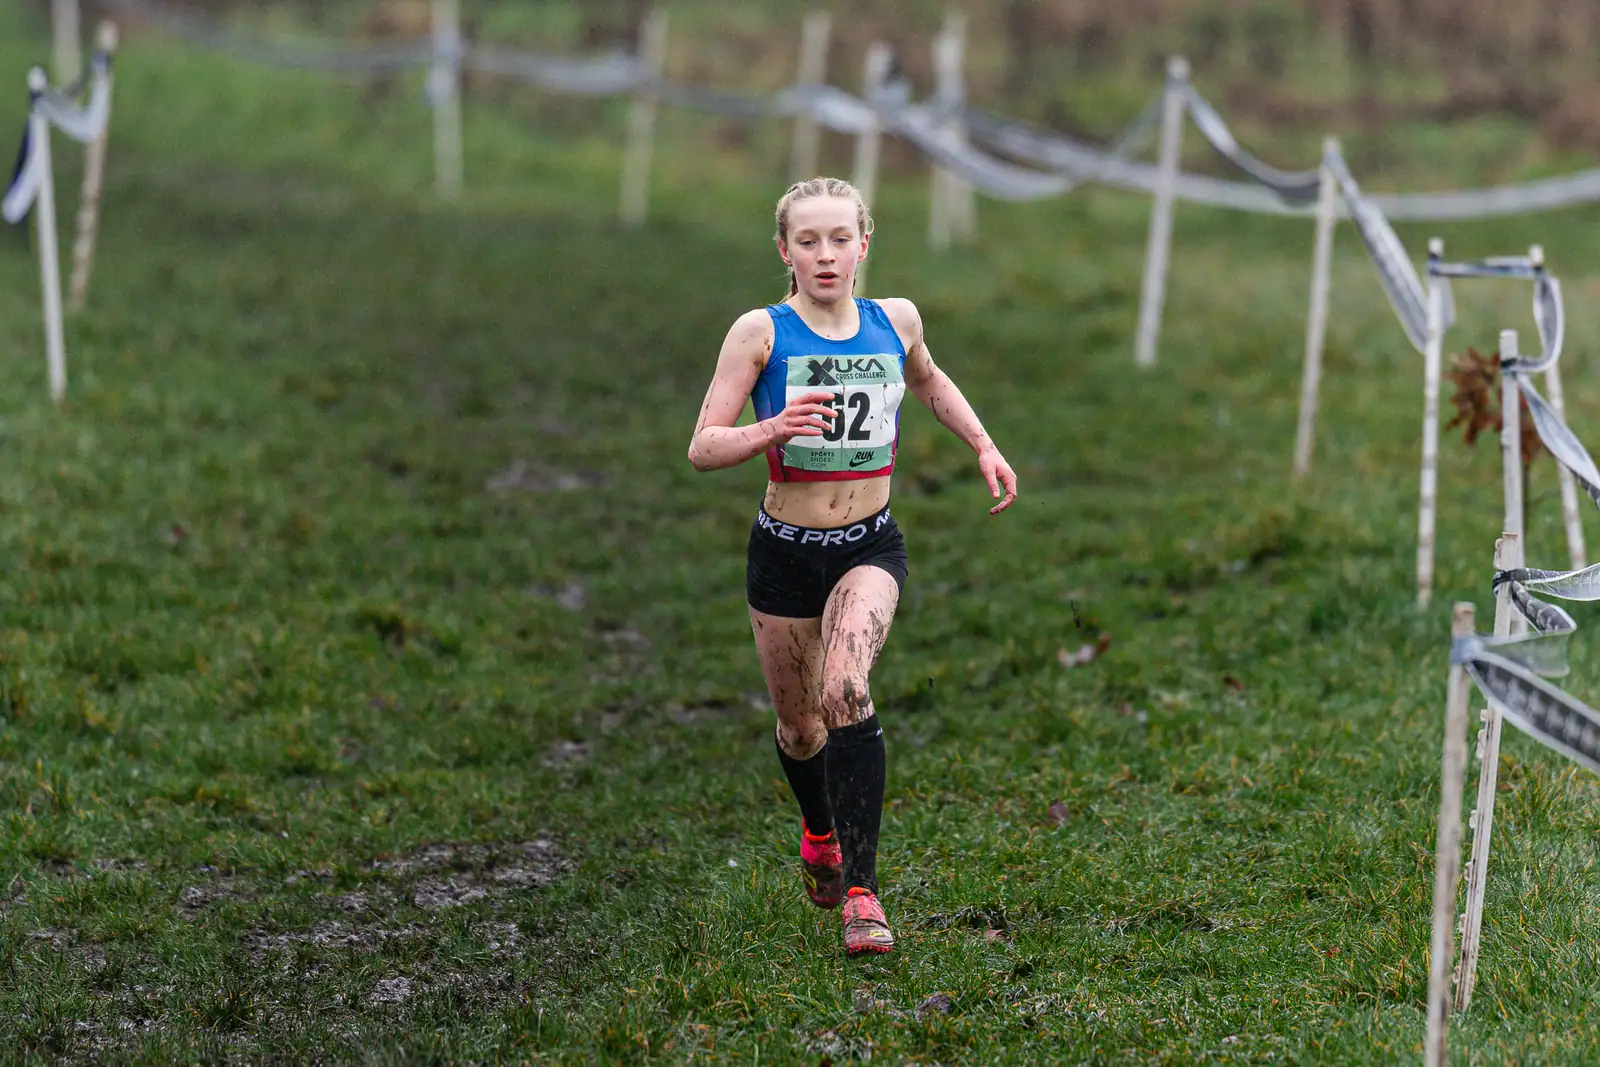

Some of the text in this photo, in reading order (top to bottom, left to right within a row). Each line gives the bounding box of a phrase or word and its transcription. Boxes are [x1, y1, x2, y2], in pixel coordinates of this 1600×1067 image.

[854, 371, 887, 379] CHALLENGE
[821, 391, 870, 441] 62
[855, 451, 875, 460] RUN
[801, 524, 867, 546] PRO
